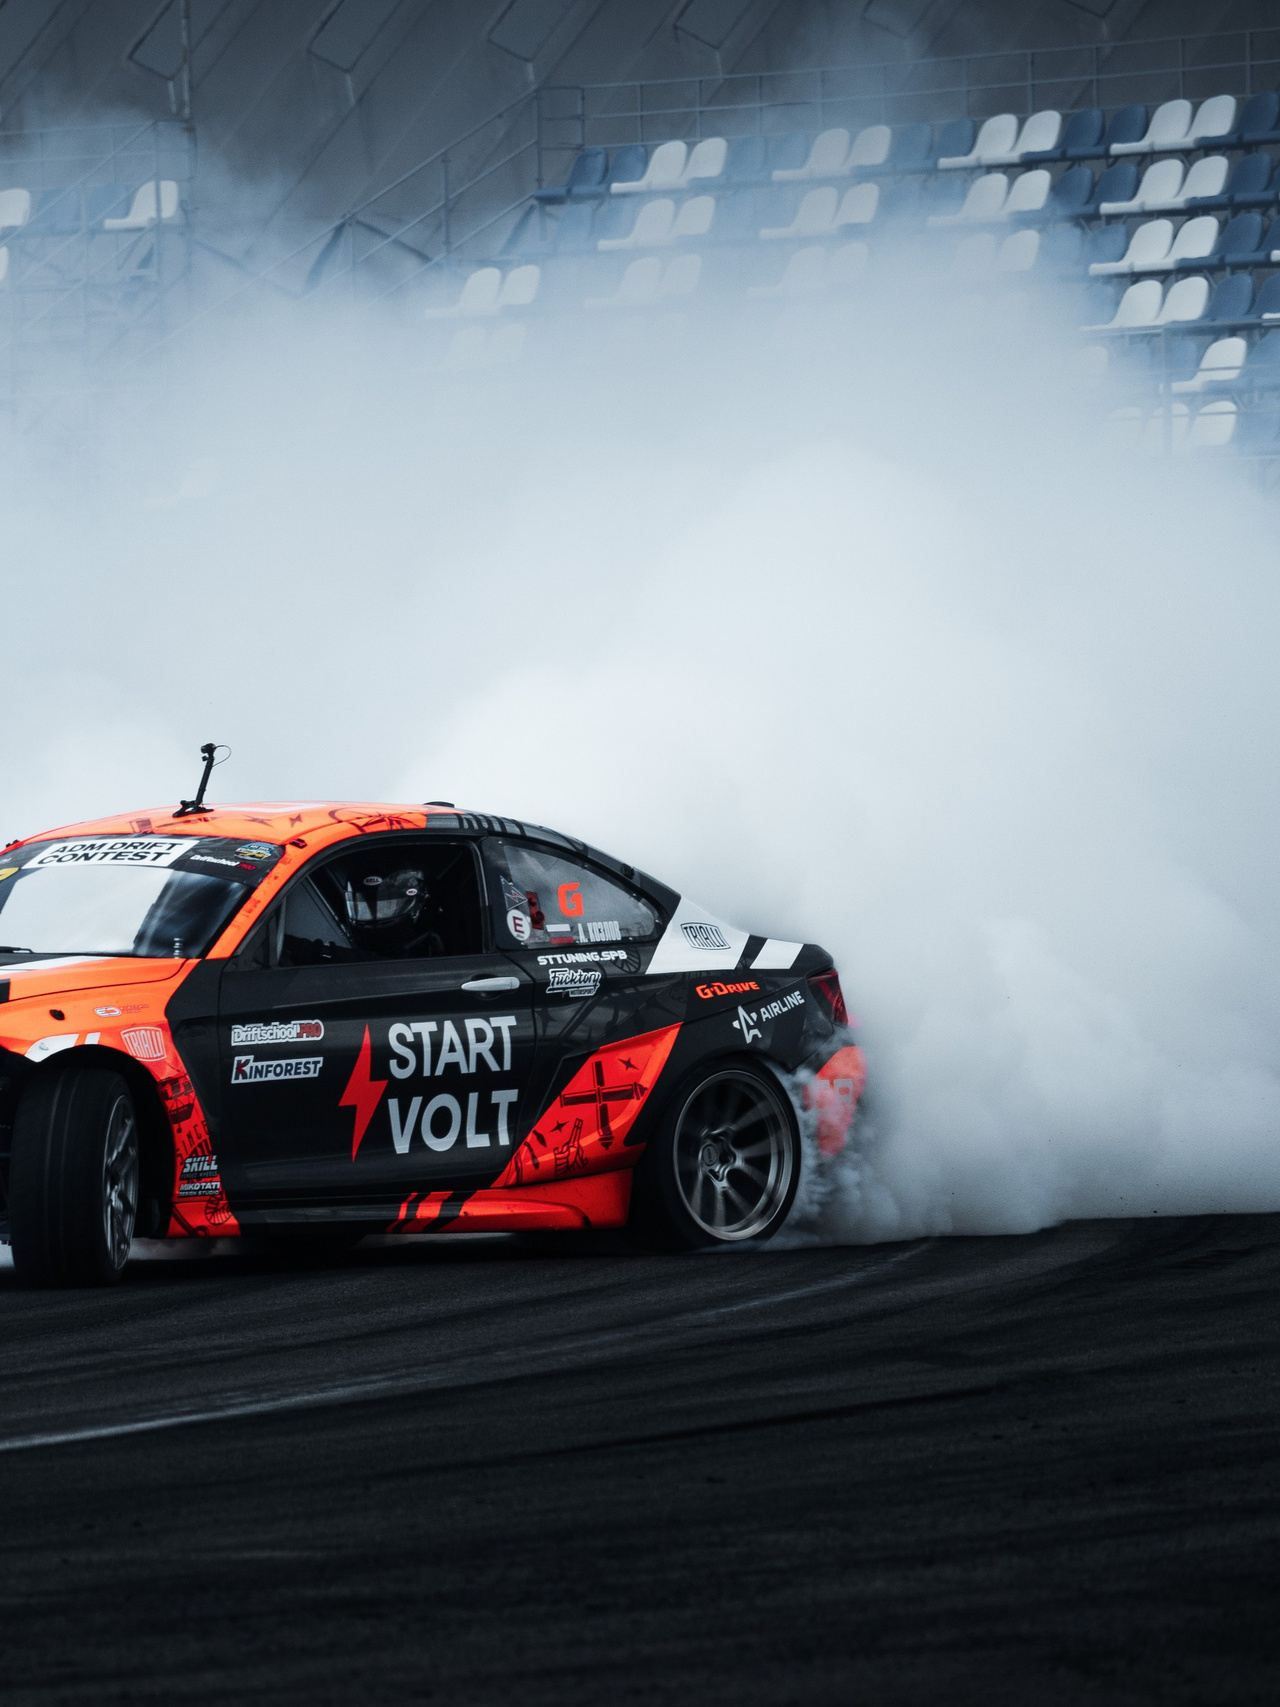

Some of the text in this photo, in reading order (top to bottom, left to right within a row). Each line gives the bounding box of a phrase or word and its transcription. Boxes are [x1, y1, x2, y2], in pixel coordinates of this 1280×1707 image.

[38, 851, 170, 864] CONTEST
[51, 841, 184, 854] ADM DRIFT
[557, 882, 584, 917] G
[513, 916, 525, 934] E
[683, 925, 727, 948] TRIALLI
[537, 950, 627, 965] STTUNING.SPB
[549, 967, 601, 991] Fucktory
[760, 991, 806, 1022] AIRLINE
[124, 1030, 164, 1058] TRIALLI
[388, 1015, 517, 1079] START
[388, 1089, 519, 1154] VOLT
[183, 1155, 218, 1173] SKILL
[180, 1182, 220, 1191] MIKOTATI
